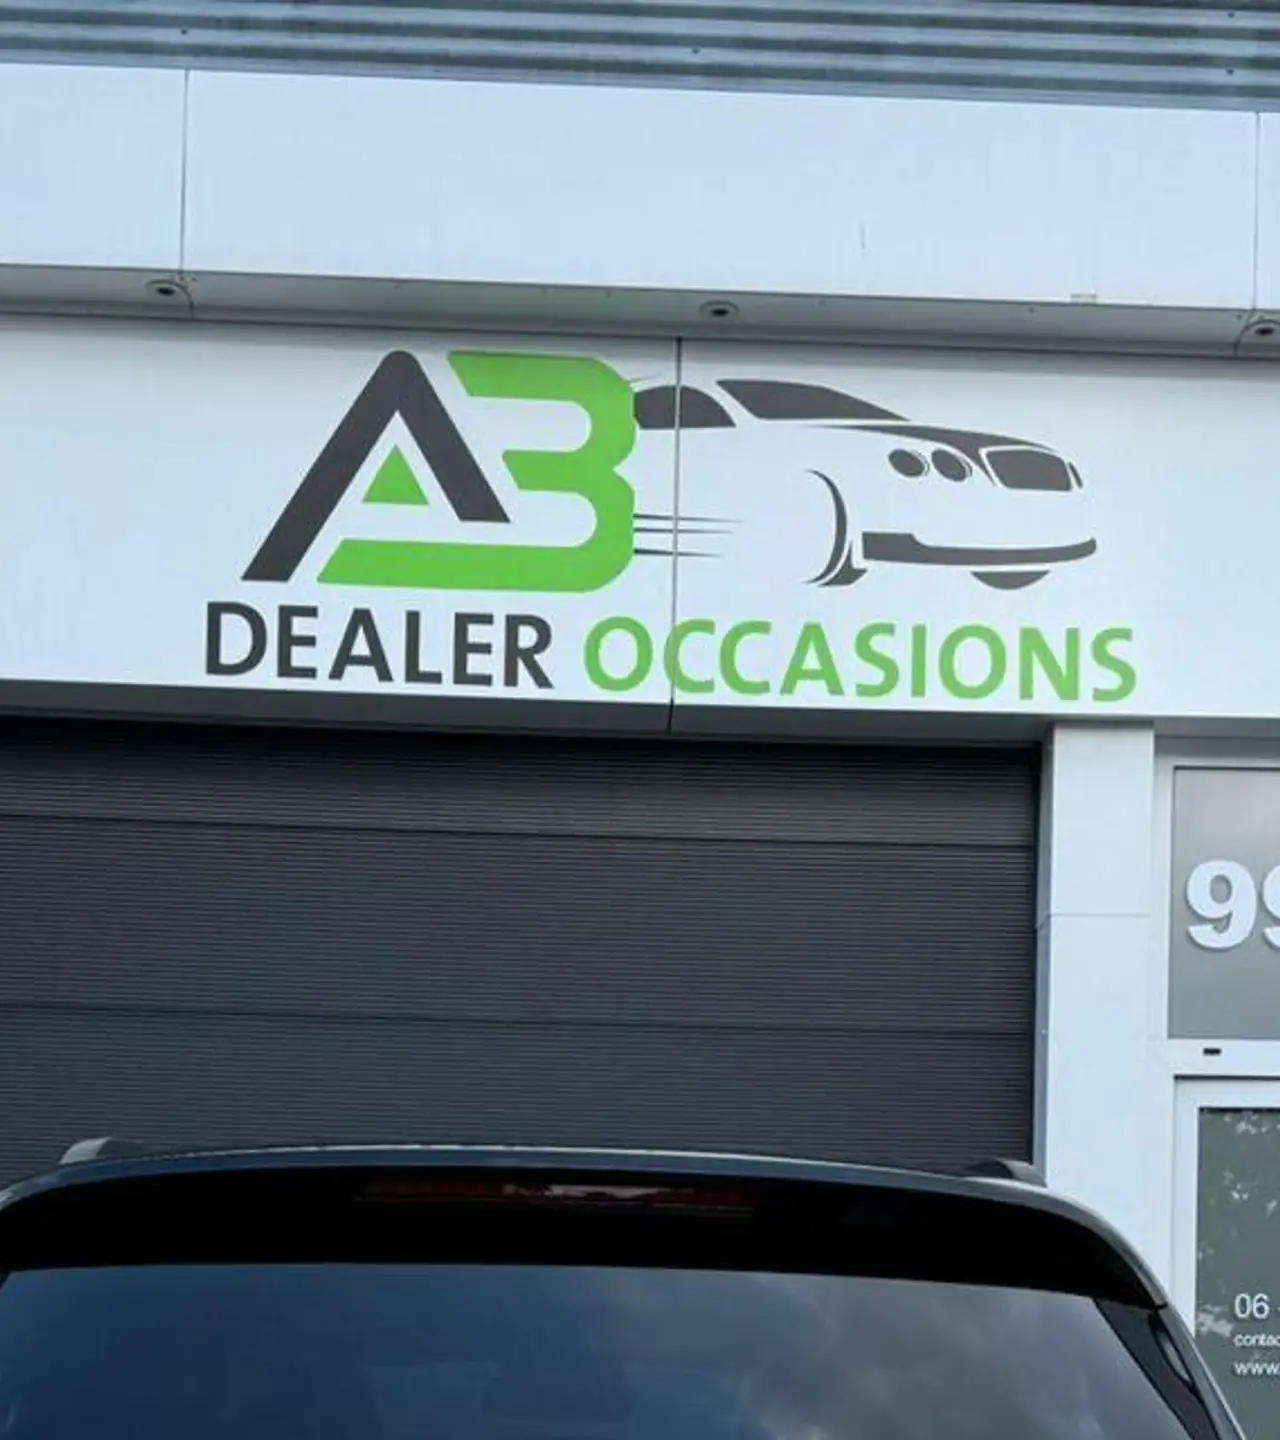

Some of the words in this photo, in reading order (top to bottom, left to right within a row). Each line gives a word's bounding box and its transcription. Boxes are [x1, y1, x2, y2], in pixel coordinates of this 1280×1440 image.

[241, 349, 636, 594] AB
[205, 602, 555, 690] DEALER
[583, 616, 1137, 703] OCCASIONS
[1234, 1293, 1269, 1320] 06
